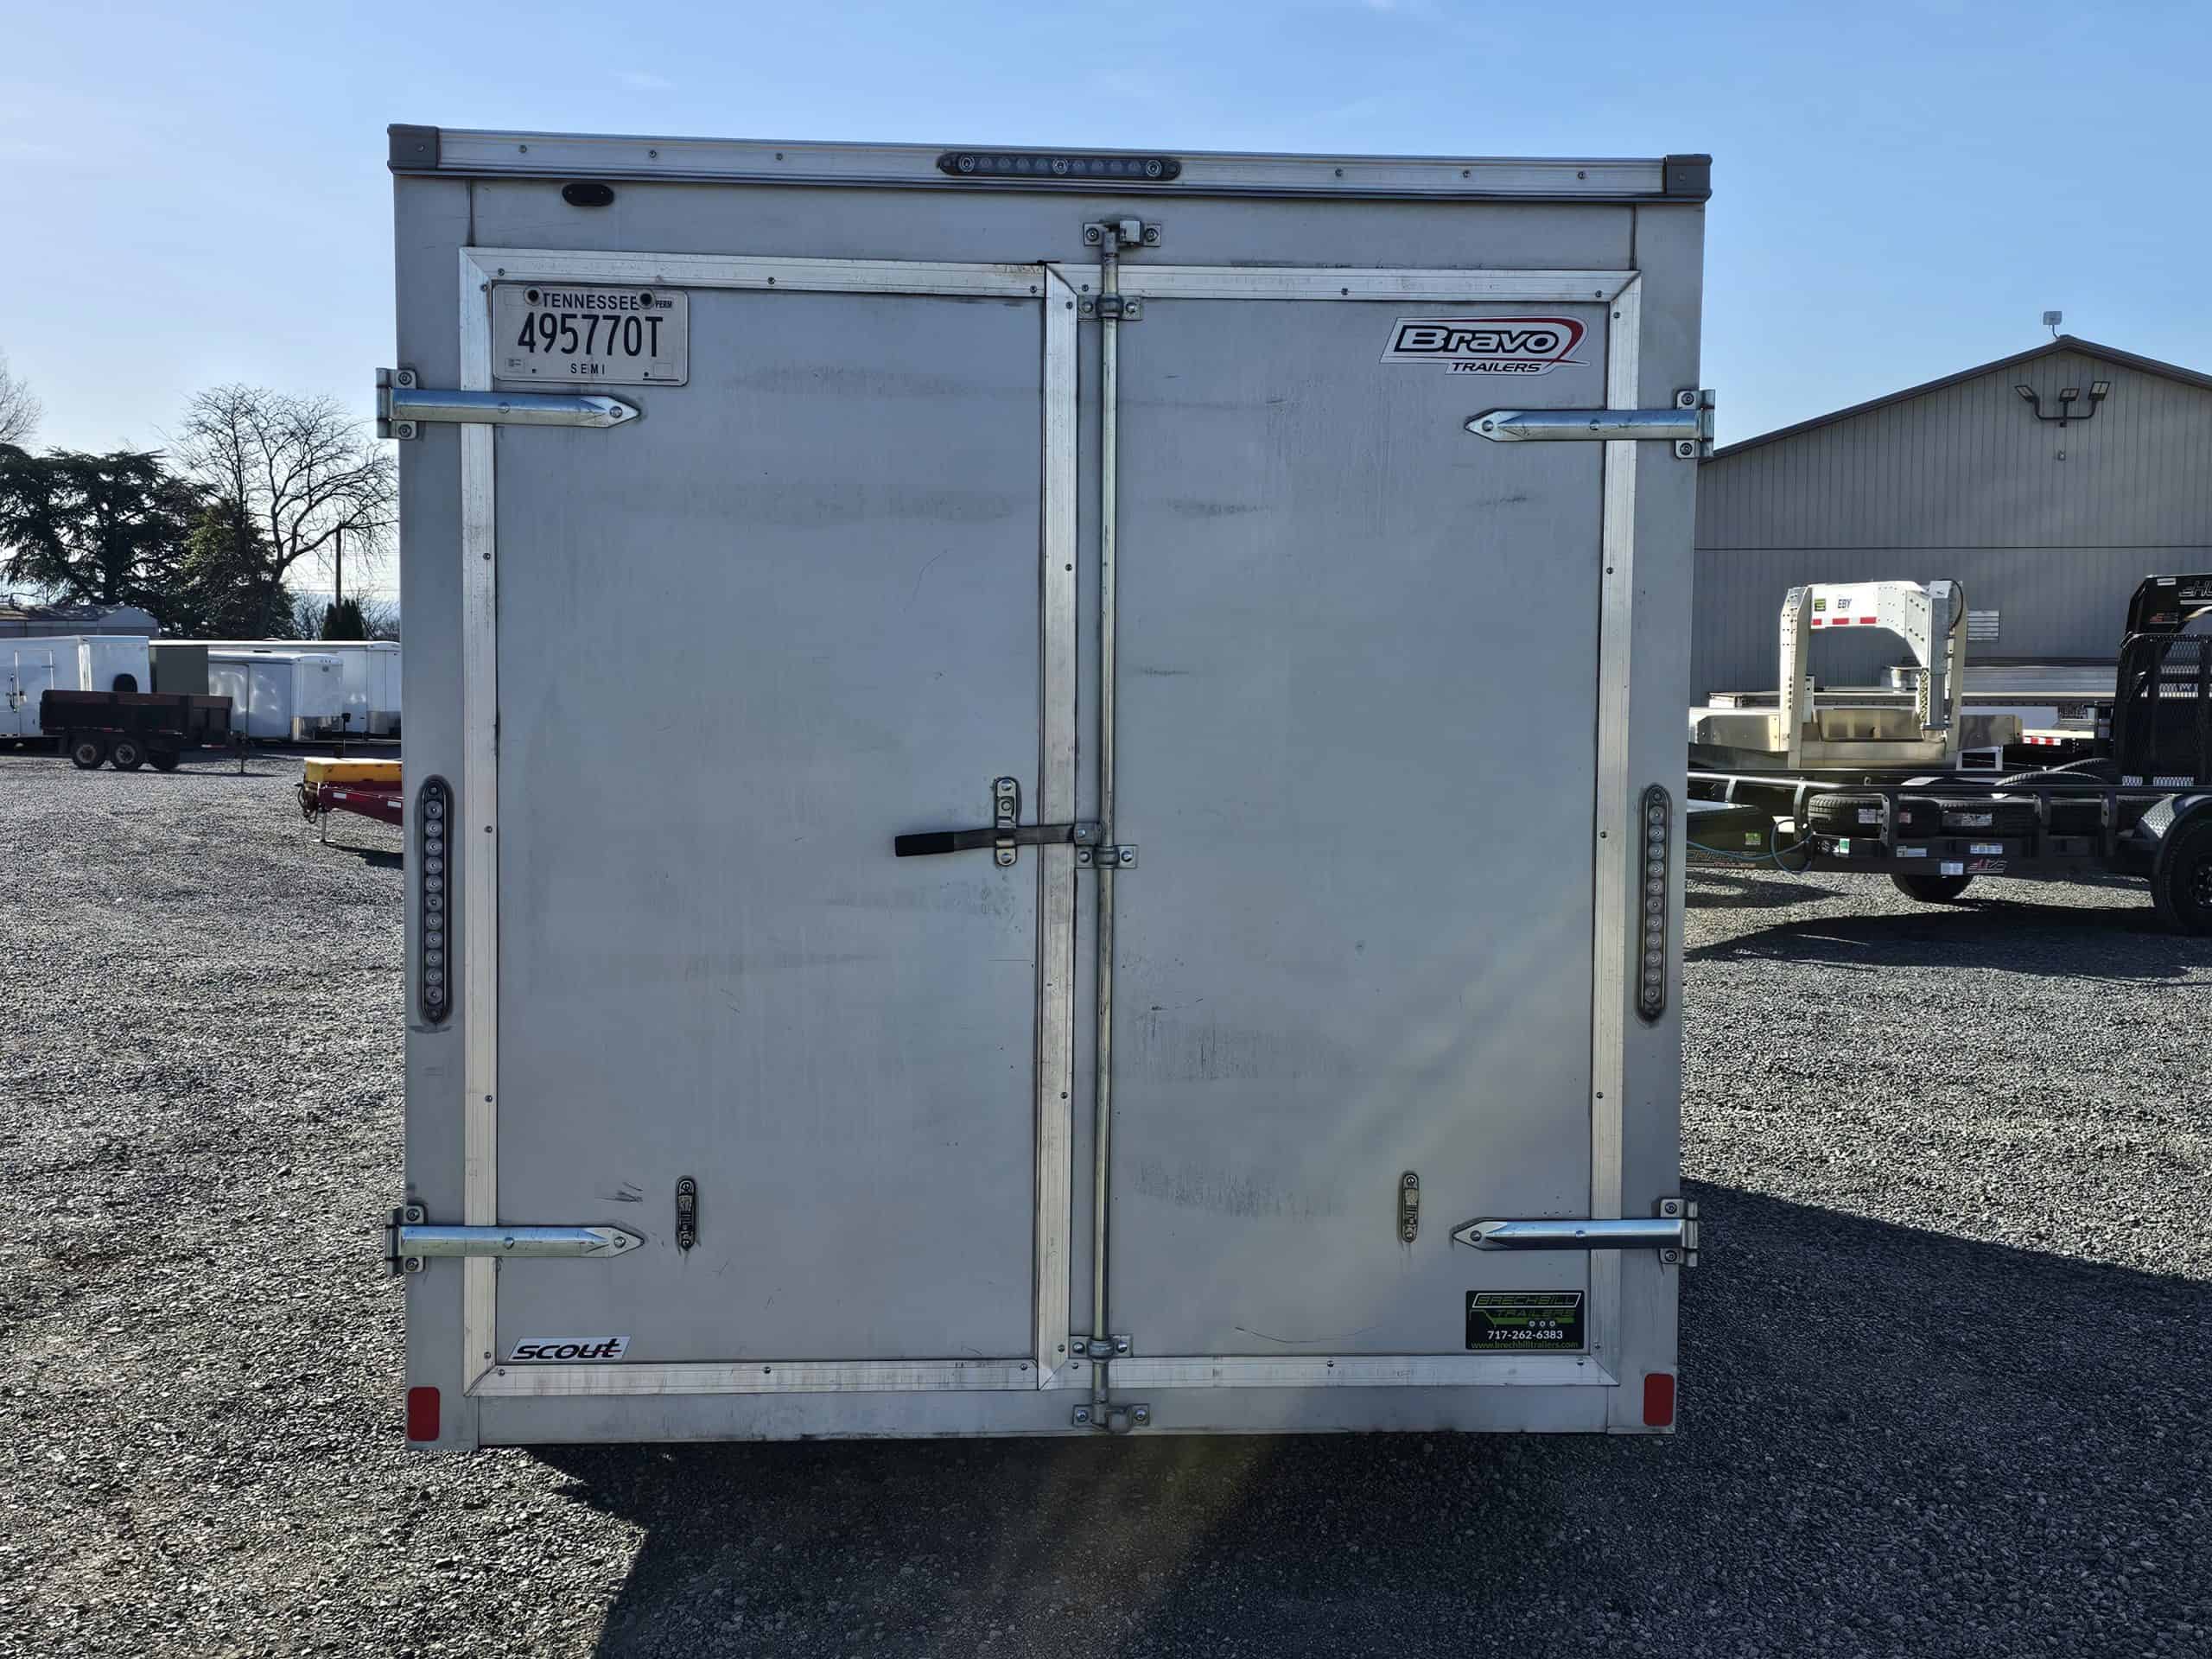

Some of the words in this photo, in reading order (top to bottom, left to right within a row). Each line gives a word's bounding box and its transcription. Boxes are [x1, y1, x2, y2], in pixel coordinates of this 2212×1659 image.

[543, 292, 639, 310] TENNESSEE
[518, 311, 664, 357] 495770T
[1394, 325, 1559, 354] Bravo
[570, 363, 605, 375] SEMI
[1452, 362, 1541, 372] TRAILERS
[1837, 598, 1852, 608] EBY
[1477, 1296, 1575, 1306] BRECHBILL
[1487, 1330, 1563, 1339] 717-262-6383
[1471, 1340, 1579, 1349] www.brechbilltrailers.com
